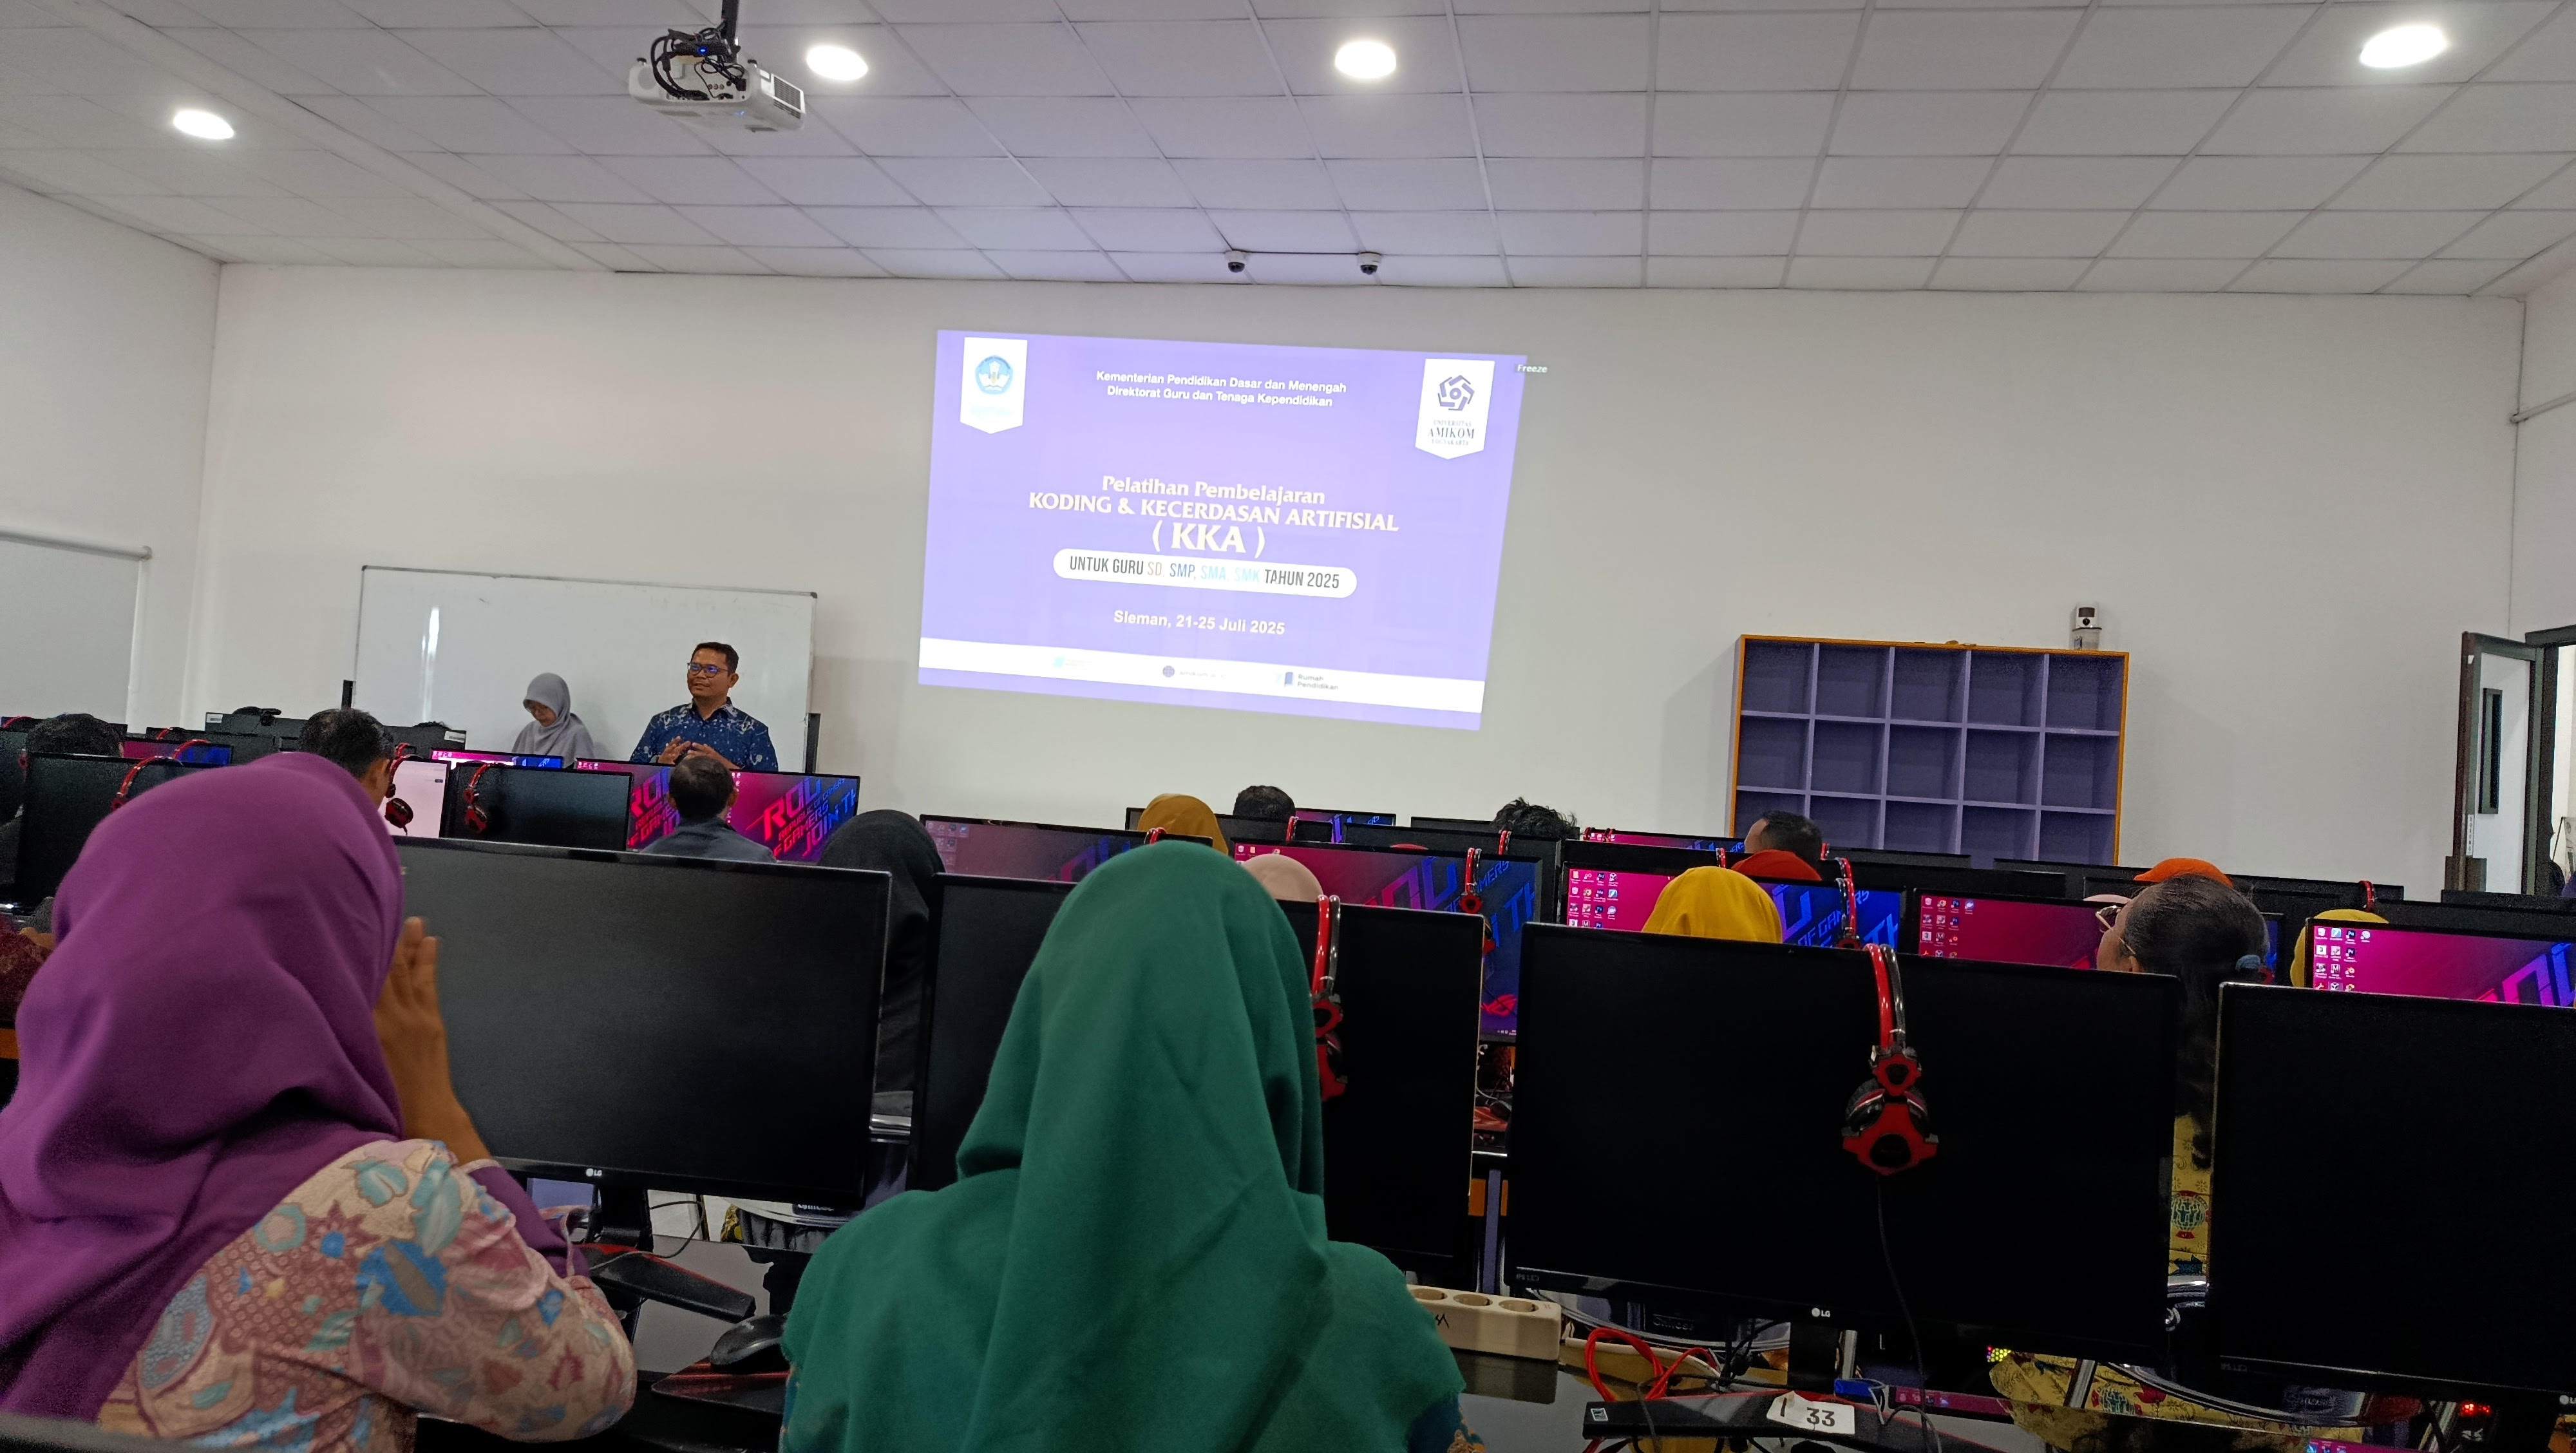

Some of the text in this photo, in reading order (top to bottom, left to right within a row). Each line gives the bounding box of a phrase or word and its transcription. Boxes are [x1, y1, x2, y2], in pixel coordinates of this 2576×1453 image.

[1517, 364, 1548, 374] Freeze
[1096, 370, 1347, 394] Kementerian Pendidikan Dasar dan Menengah
[1107, 385, 1333, 407] Direktorat Guru dan Tenaga Kependidikan
[1428, 426, 1475, 439] AMIKOM
[1102, 475, 1325, 506] Pelatihan Pembelajaran
[1028, 491, 1399, 531] KODING & KECERDASAN ARTIFISIAL
[1170, 522, 1247, 554] KKA
[1069, 555, 1110, 573] UNTUK
[1112, 558, 1144, 575] GURU
[1169, 562, 1197, 580] SMP,
[1264, 569, 1305, 587] TAHUN
[1307, 571, 1340, 589] 2025
[1113, 609, 1285, 635] Sleman, 21-25 Juli 2025
[1297, 681, 1339, 690] Pendidikan
[1298, 673, 1324, 681] Rumah
[1806, 1407, 1835, 1427] 33
